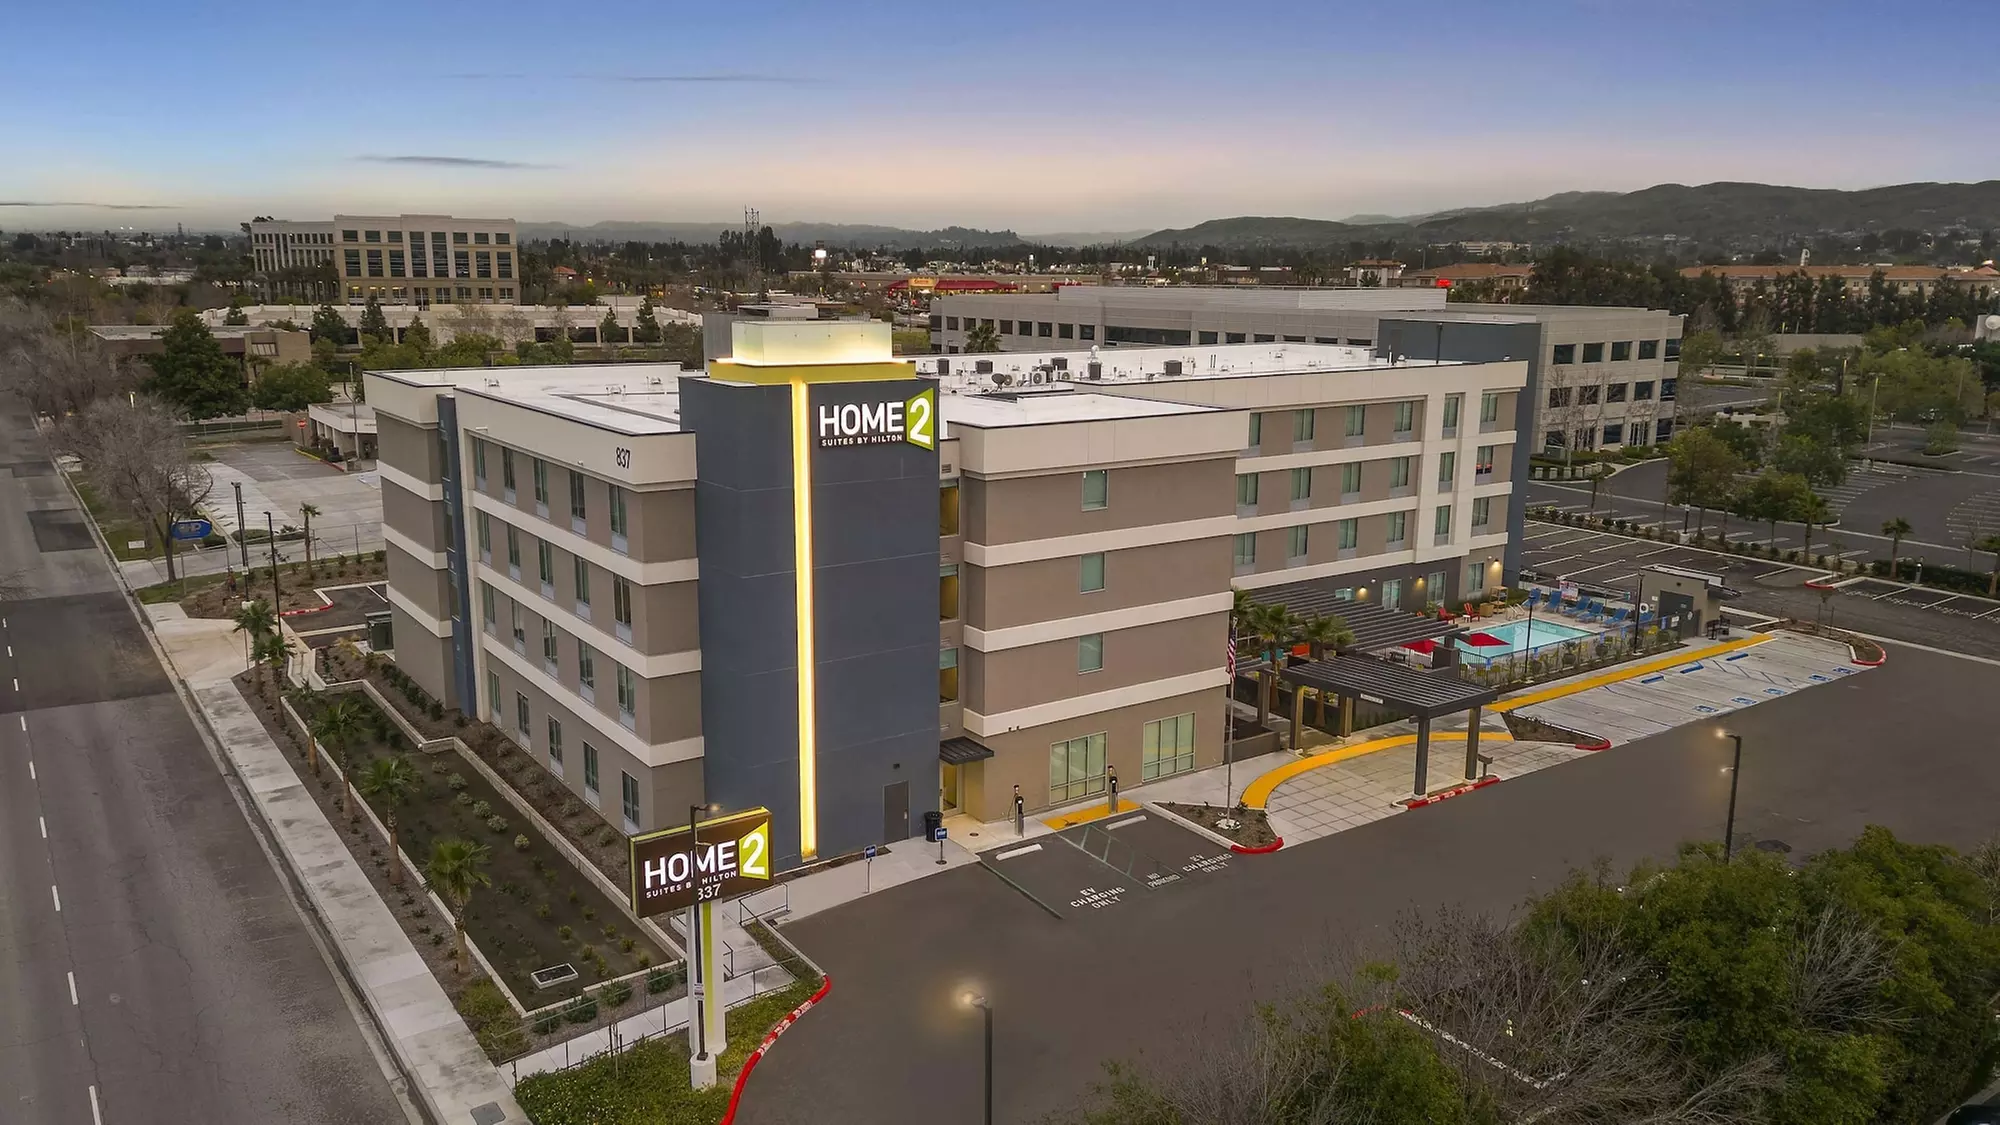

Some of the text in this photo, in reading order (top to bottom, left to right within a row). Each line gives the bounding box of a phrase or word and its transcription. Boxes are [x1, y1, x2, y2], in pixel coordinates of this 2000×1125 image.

[819, 397, 931, 445] HOME 2
[822, 434, 903, 447] SUITES BY HILTON
[616, 446, 631, 469] 837
[644, 832, 766, 889] HOME 2
[1182, 852, 1233, 872] CHARGING
[1201, 861, 1229, 873] ONLY
[646, 884, 682, 899] SUITES
[701, 870, 737, 885] HILTON
[1080, 887, 1096, 896] EV
[1070, 887, 1126, 907] CHARGING
[1091, 896, 1121, 909] ONLY
